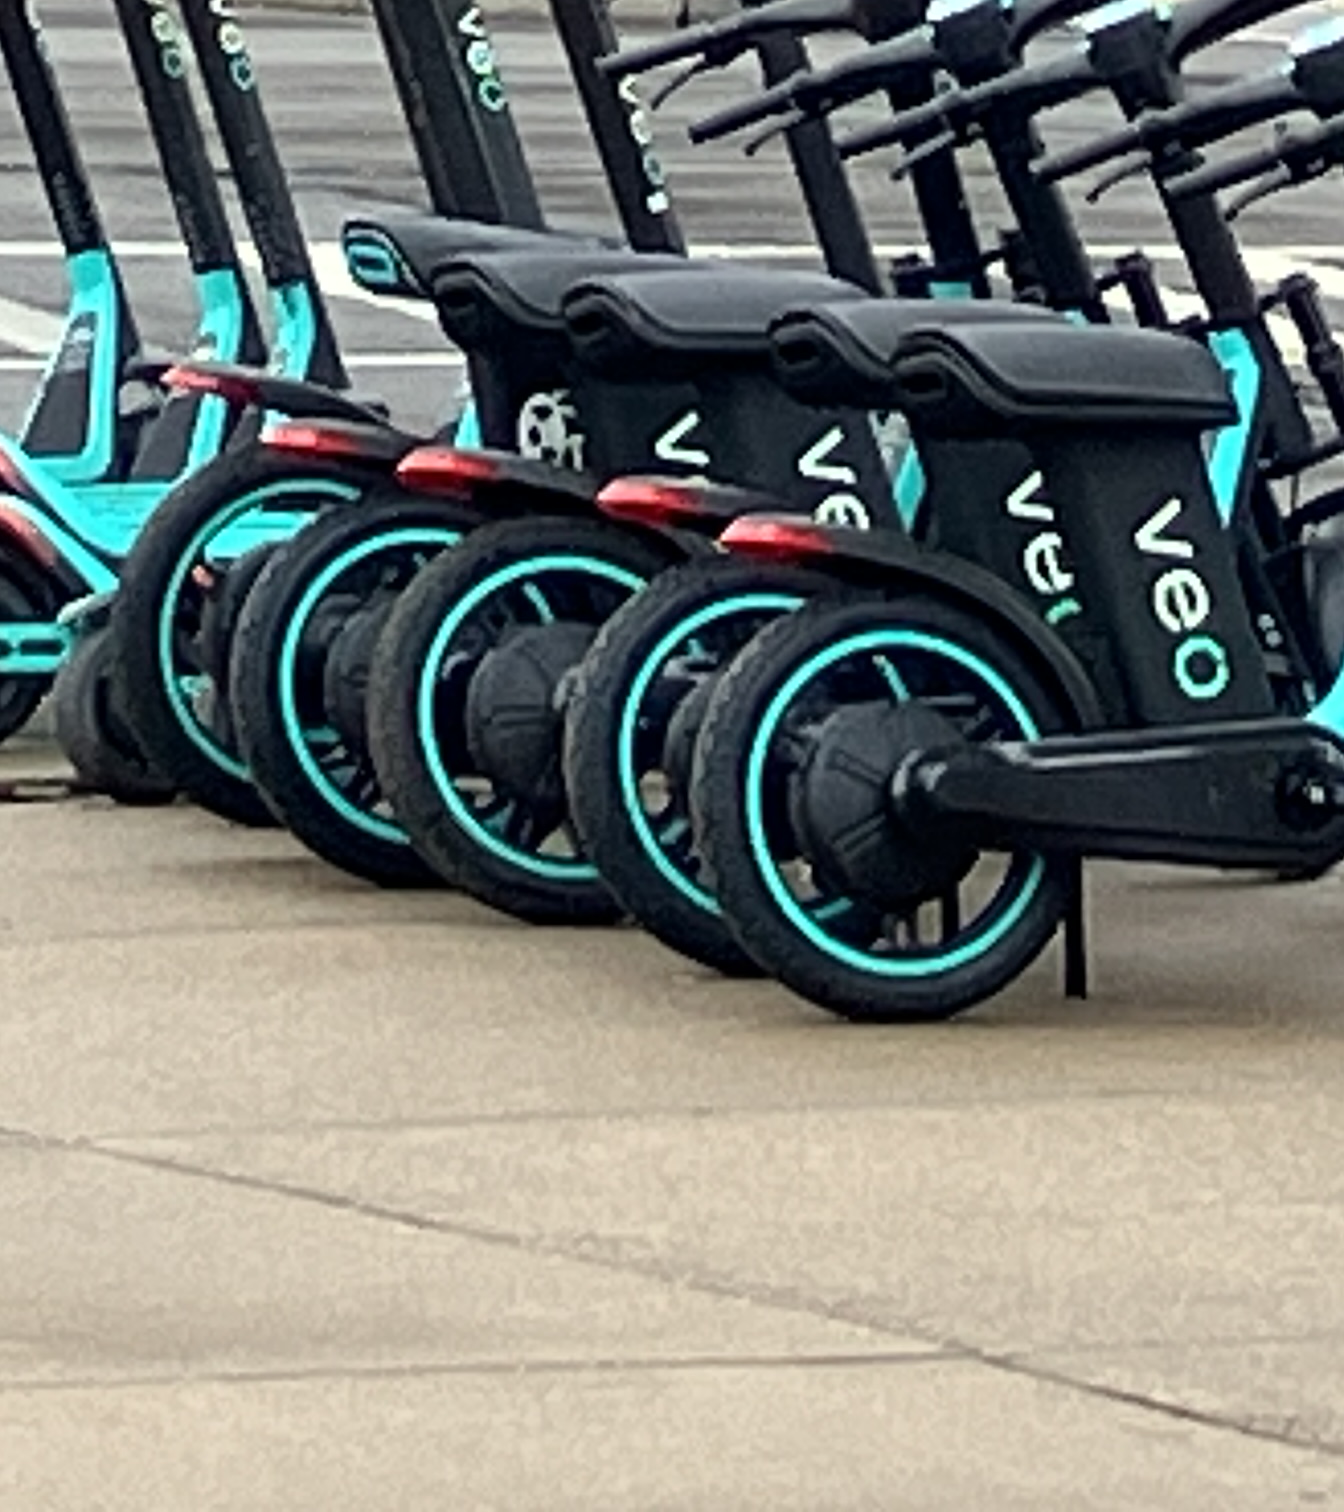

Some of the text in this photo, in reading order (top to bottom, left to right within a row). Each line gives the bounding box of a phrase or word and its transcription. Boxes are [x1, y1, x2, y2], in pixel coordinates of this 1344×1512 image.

[458, 6, 506, 112] veo
[1006, 469, 1083, 625] ve
[1133, 497, 1231, 700] veo
